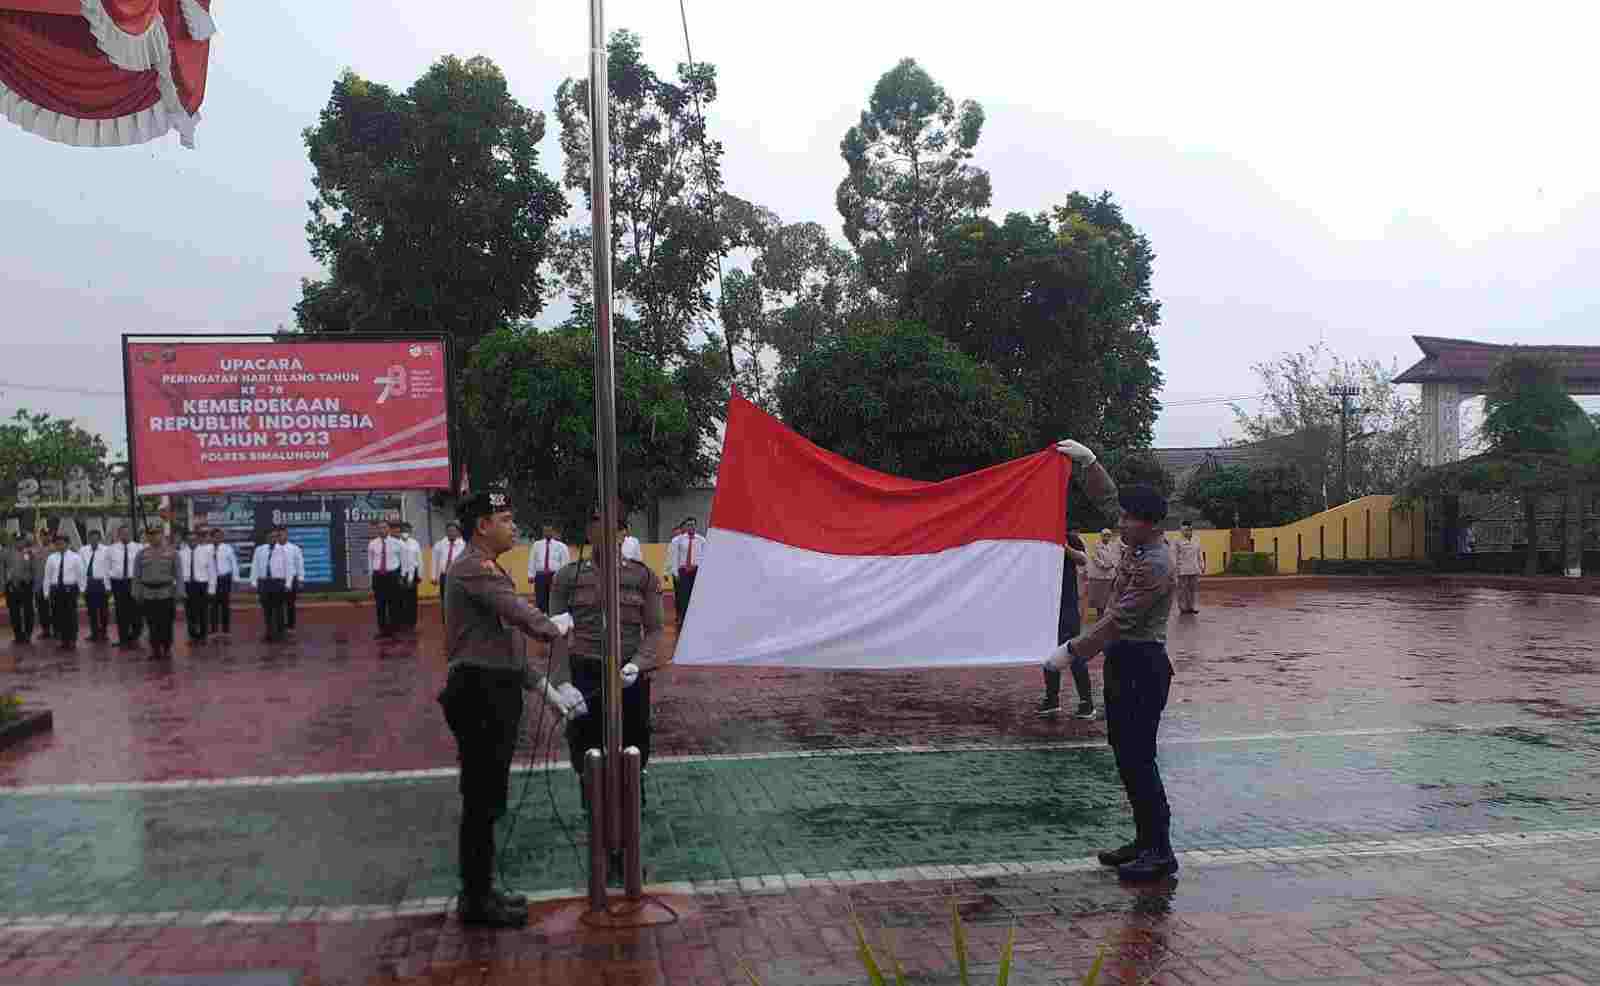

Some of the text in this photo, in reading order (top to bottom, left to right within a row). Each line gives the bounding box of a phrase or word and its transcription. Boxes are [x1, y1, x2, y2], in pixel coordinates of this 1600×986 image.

[220, 357, 304, 371] UPACARA
[161, 372, 360, 384] PERINGATAN HARI ULANG TAHUN
[182, 397, 340, 414] KEMERDEKAAN
[149, 414, 374, 432] REPUBLIK INDONESIA
[195, 431, 330, 448] TAHUN 2023
[200, 451, 247, 463] POLRES
